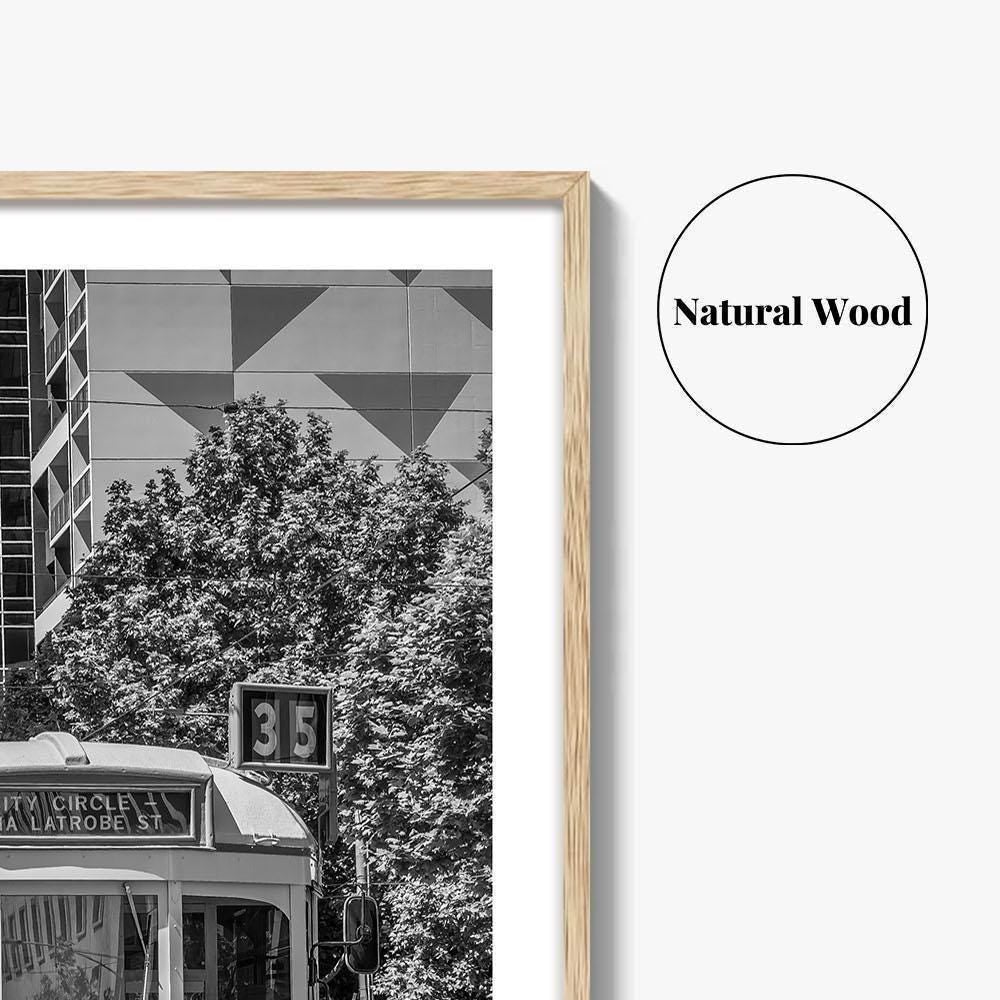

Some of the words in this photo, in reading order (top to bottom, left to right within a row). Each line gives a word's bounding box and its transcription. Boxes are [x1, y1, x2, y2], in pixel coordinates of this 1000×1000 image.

[52, 794, 131, 812] CIRCLE
[31, 815, 125, 831] LATROBE
[137, 815, 162, 830] ST
